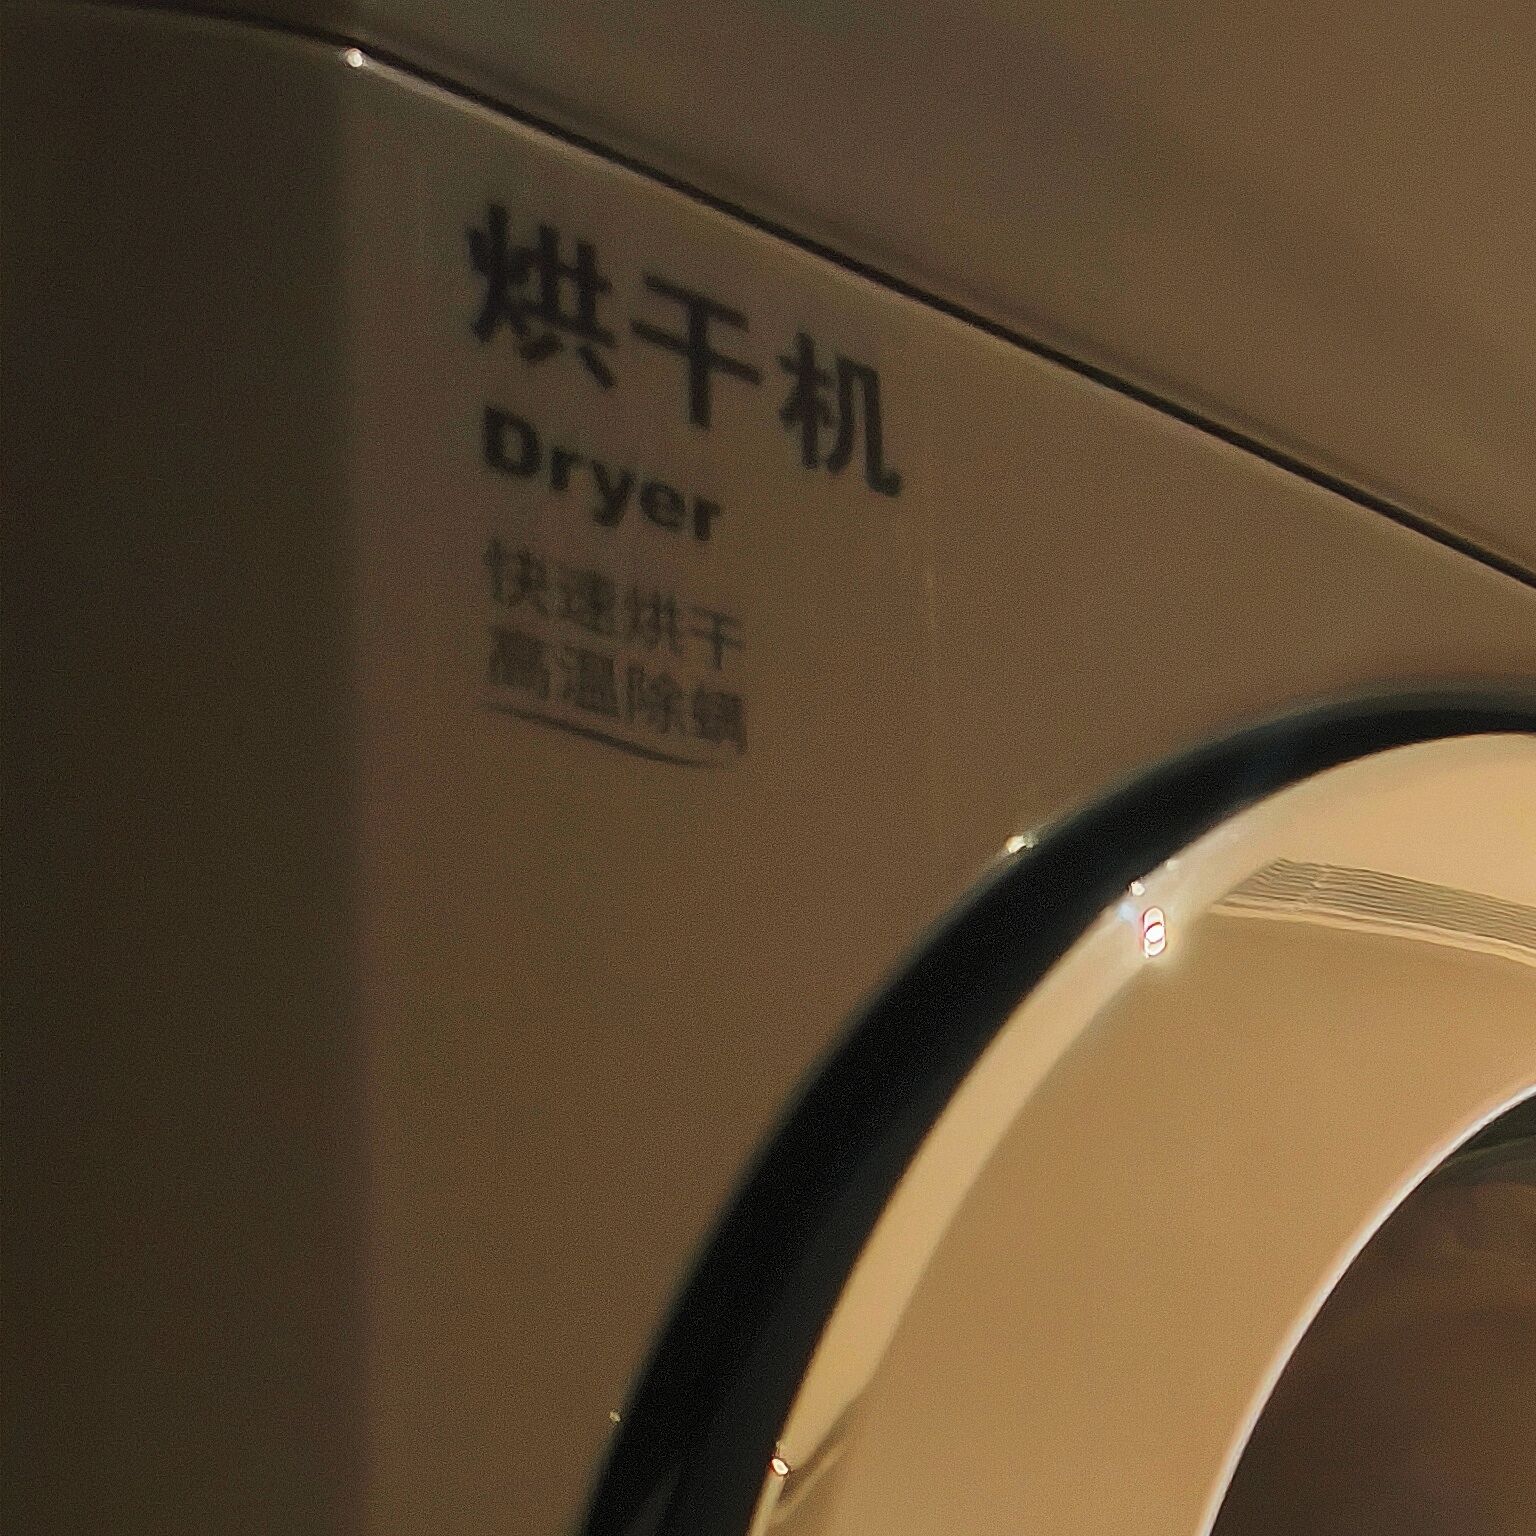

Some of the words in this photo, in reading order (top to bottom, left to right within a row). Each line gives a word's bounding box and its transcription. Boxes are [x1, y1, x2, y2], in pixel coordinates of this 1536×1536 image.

[467, 203, 902, 497] 烘干机
[483, 407, 722, 541] Dryer
[483, 537, 746, 671] 快速烘干
